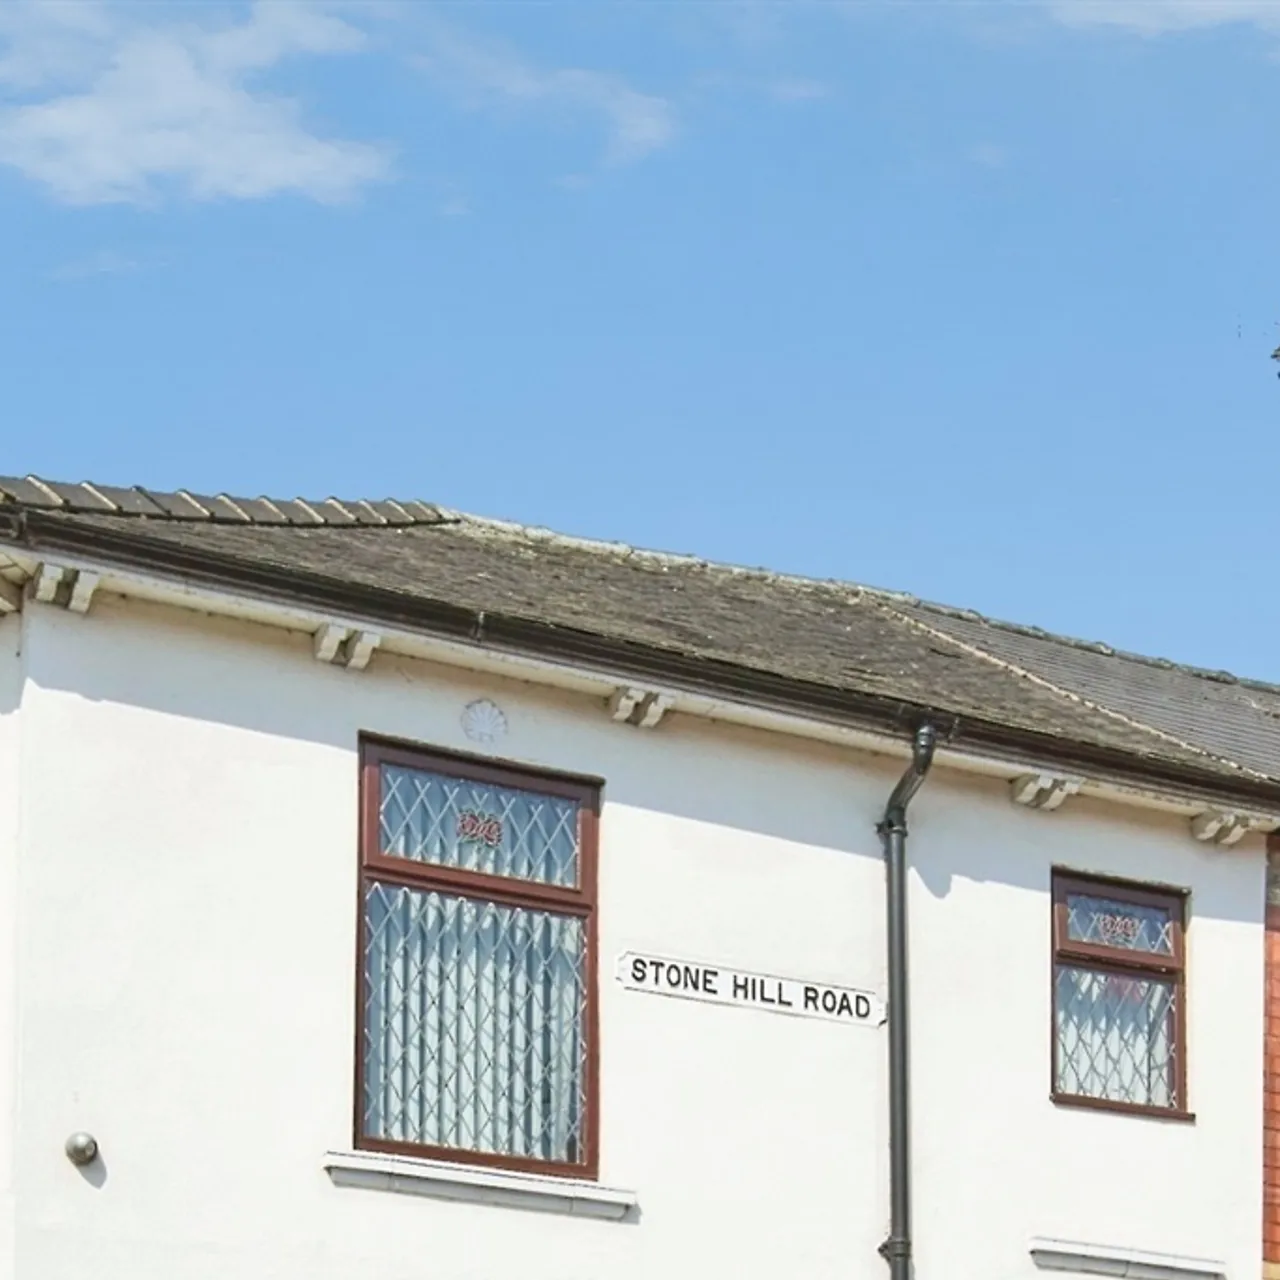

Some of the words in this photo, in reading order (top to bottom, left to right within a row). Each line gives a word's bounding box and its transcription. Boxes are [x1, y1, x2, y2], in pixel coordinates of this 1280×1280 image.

[631, 958, 718, 995] STONE
[733, 974, 792, 1006] HILL
[804, 986, 870, 1018] ROAD
